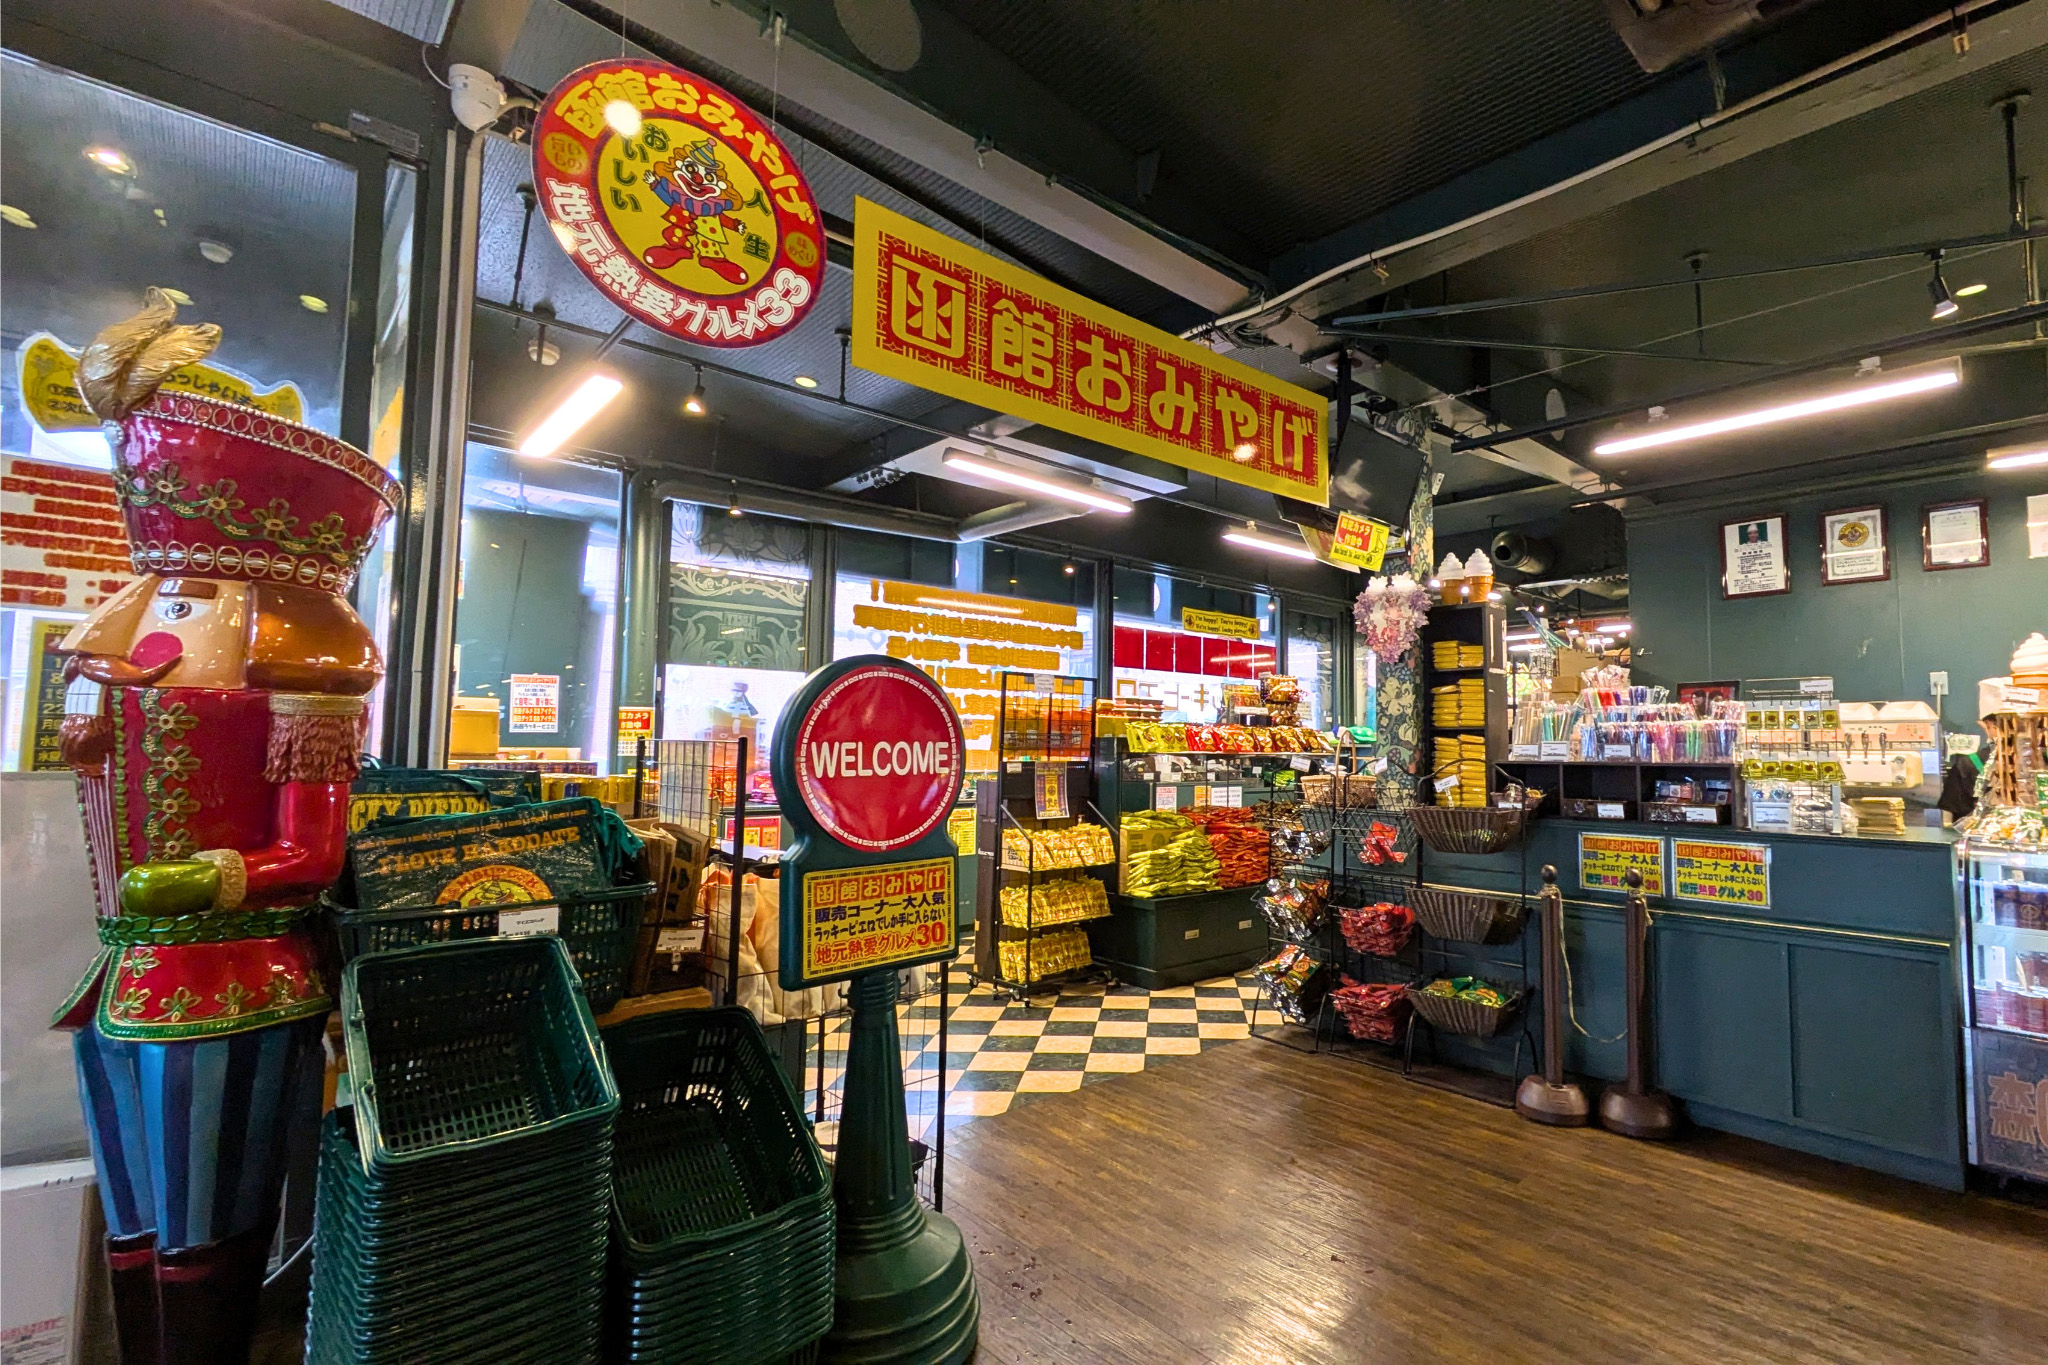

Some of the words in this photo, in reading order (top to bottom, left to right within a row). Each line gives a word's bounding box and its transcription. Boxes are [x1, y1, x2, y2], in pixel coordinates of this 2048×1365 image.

[554, 68, 815, 226] 函館おみやげ
[608, 123, 671, 213] おいしい
[545, 176, 812, 340] 地元熱愛グルメ33
[890, 253, 1315, 473] 函館おみやげ
[810, 740, 950, 780] WELCOME
[392, 847, 458, 874] LOVE
[460, 825, 582, 863] HAKODATE
[1583, 837, 1660, 855] 函館おみやげ
[1583, 850, 1661, 867] 販売コーナー大人気
[1676, 843, 1765, 863] 函館おみやげ
[1676, 857, 1765, 876] 販売コーナー大人気
[814, 869, 946, 906] 函館おみやげ
[1679, 881, 1765, 902] 地元熱愛グルメ30
[813, 907, 946, 942] ラッキーピエロでしか手に入らない
[814, 890, 946, 925] 販売コーナー大人気
[814, 920, 946, 966] 地元熱愛グルメ30
